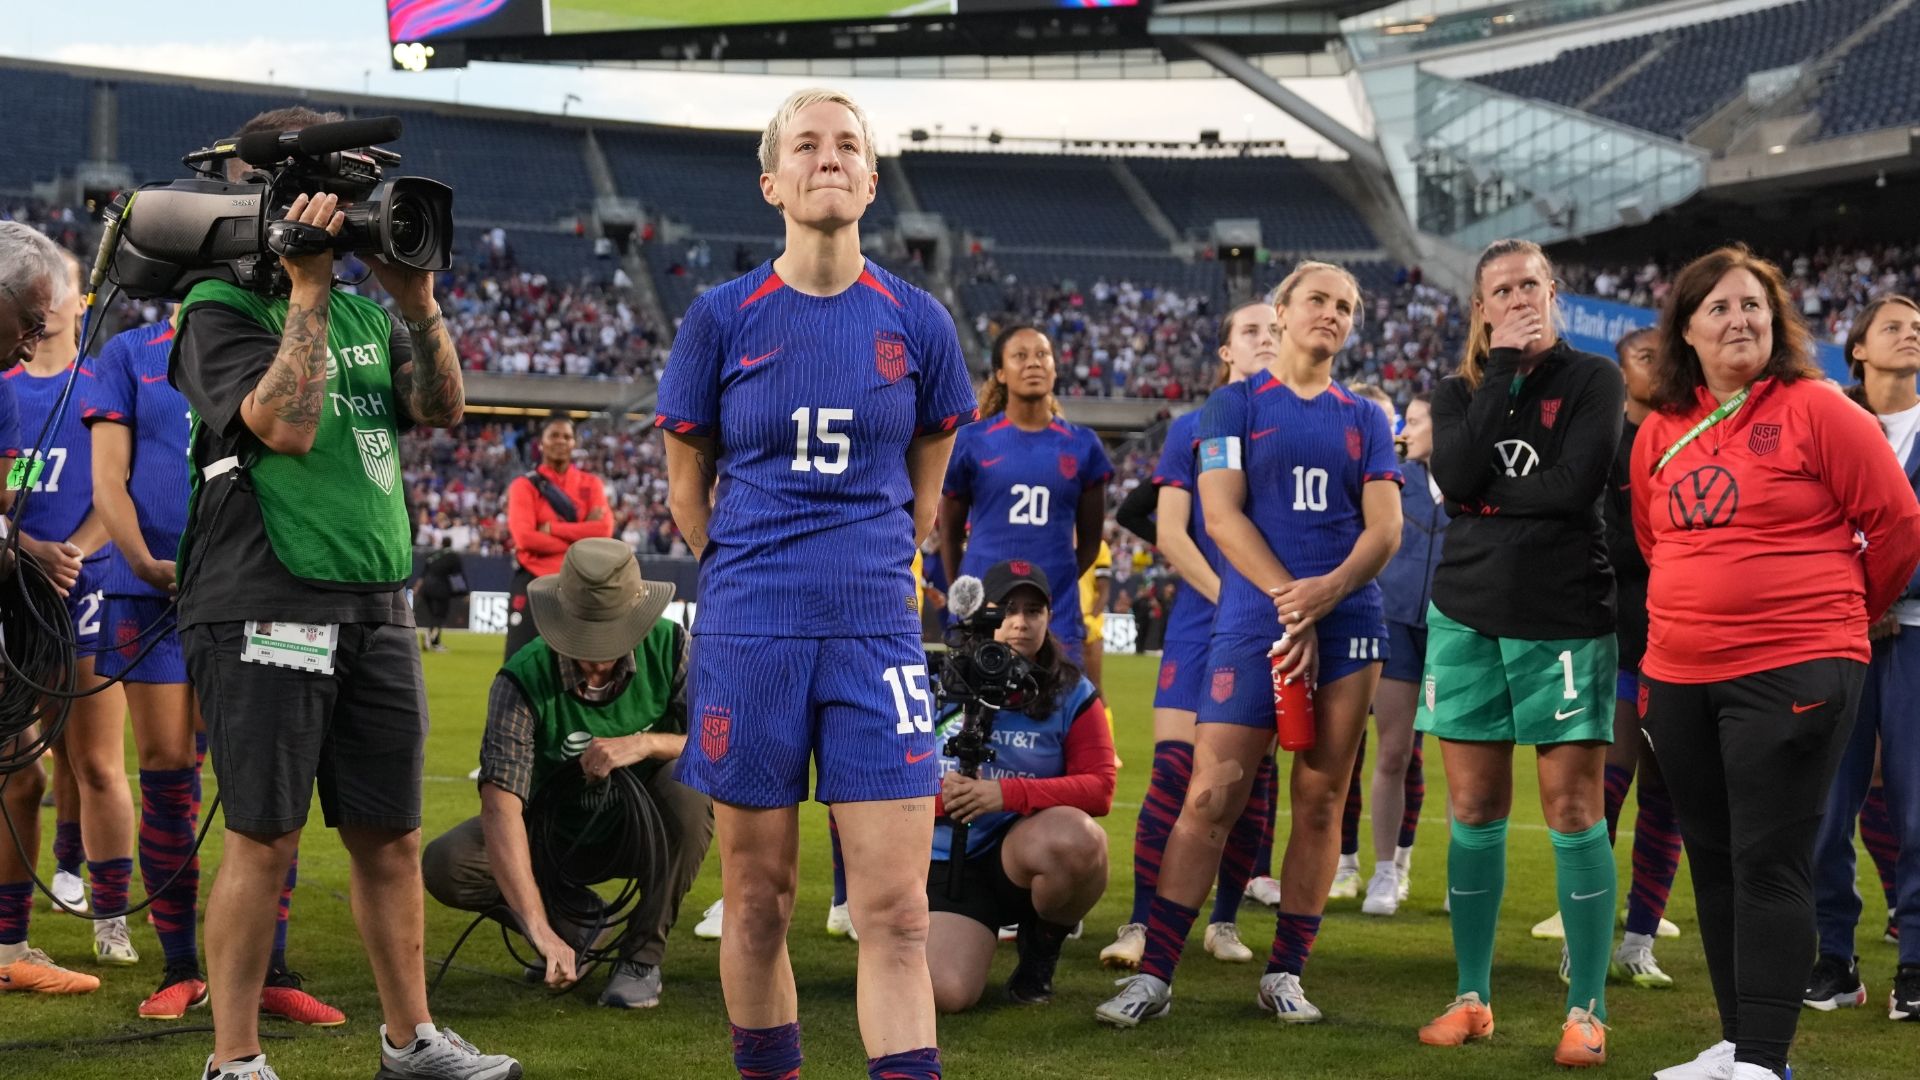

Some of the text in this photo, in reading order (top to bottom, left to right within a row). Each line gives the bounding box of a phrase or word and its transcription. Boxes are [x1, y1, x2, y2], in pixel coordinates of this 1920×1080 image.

[231, 199, 256, 207] SONY
[1574, 304, 1605, 339] Bank
[1607, 314, 1625, 342] of
[340, 344, 379, 368] T&T
[877, 341, 903, 360] USA
[358, 432, 391, 458] USA
[791, 407, 854, 474] 15
[1755, 426, 1778, 438] USA
[1009, 483, 1050, 526] 20
[1292, 465, 1329, 512] 10
[78, 589, 104, 635] 2
[475, 596, 509, 628] US
[1558, 650, 1578, 699] 1
[883, 664, 933, 734] 15
[703, 717, 729, 737] USA
[991, 730, 1041, 750] AT&T
